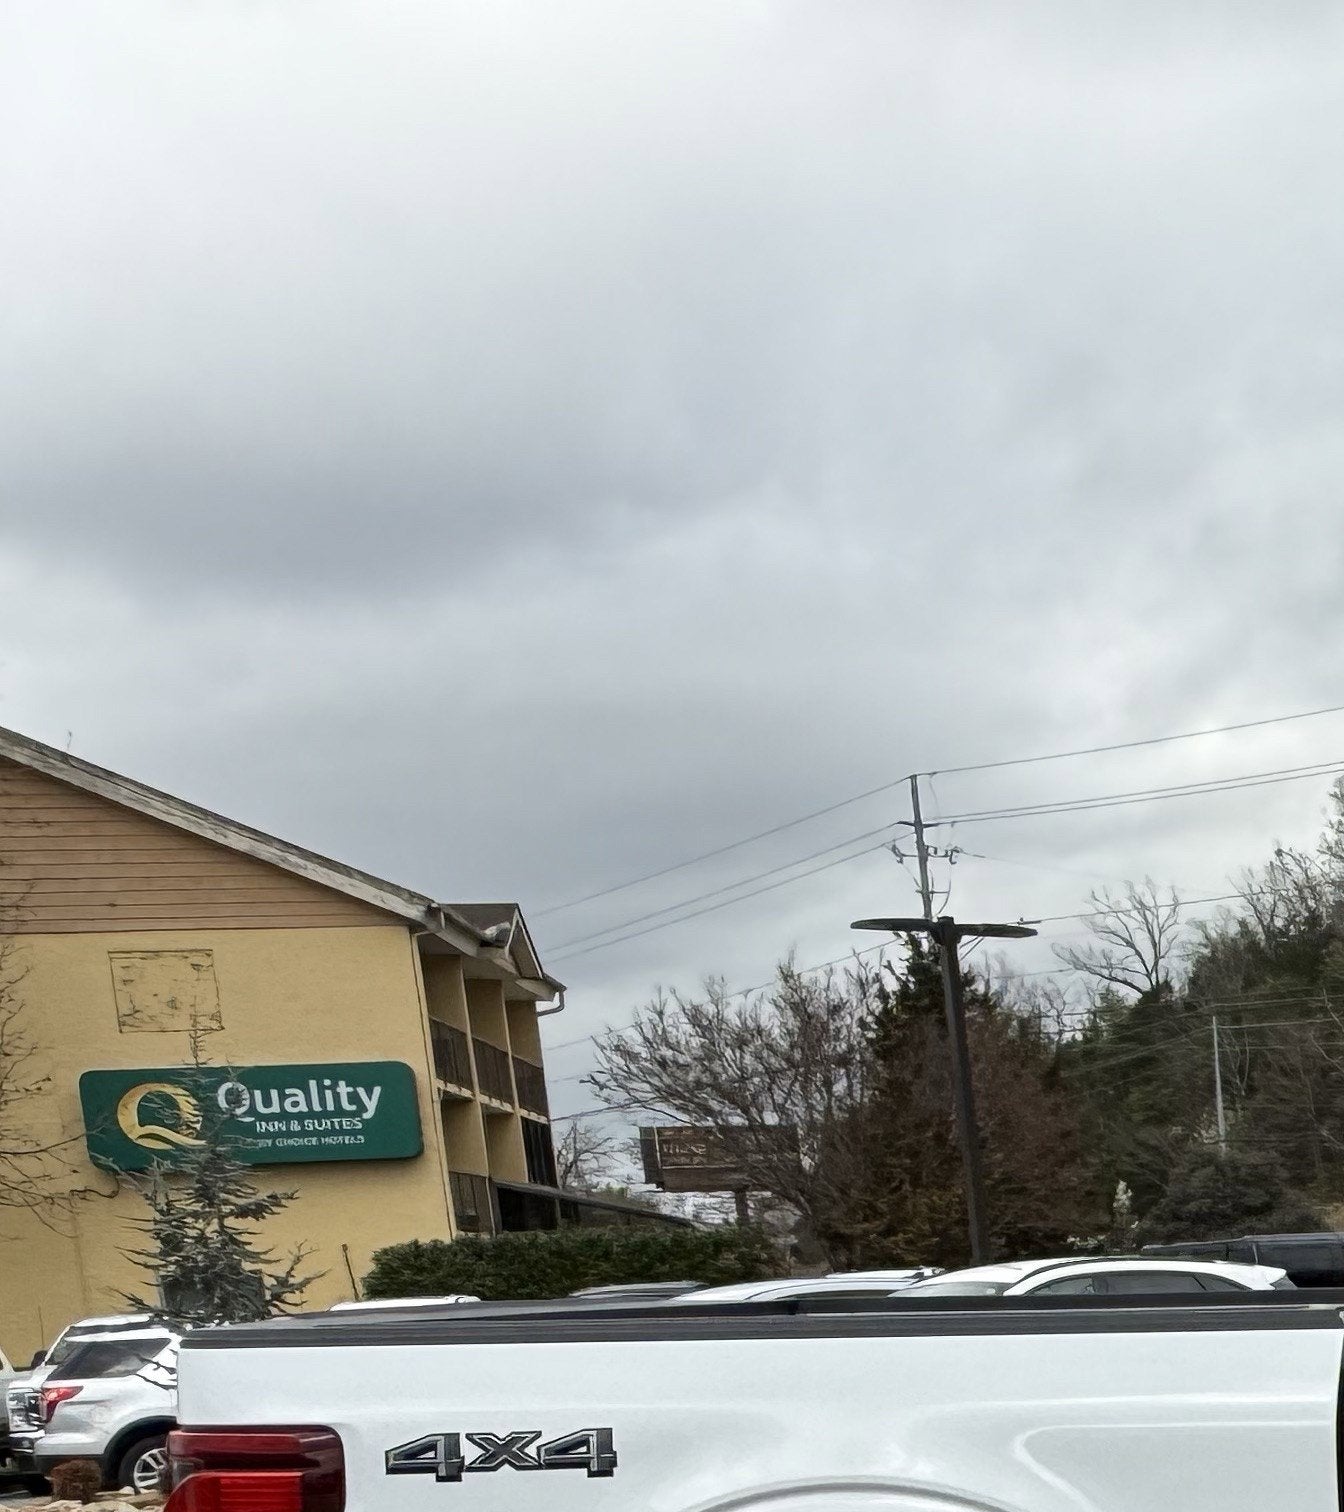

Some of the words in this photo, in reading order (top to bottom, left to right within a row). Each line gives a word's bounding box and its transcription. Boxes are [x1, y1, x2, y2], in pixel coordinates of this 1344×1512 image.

[217, 1078, 382, 1122] Quality
[255, 1120, 287, 1133] INN
[303, 1117, 363, 1131] SUITES
